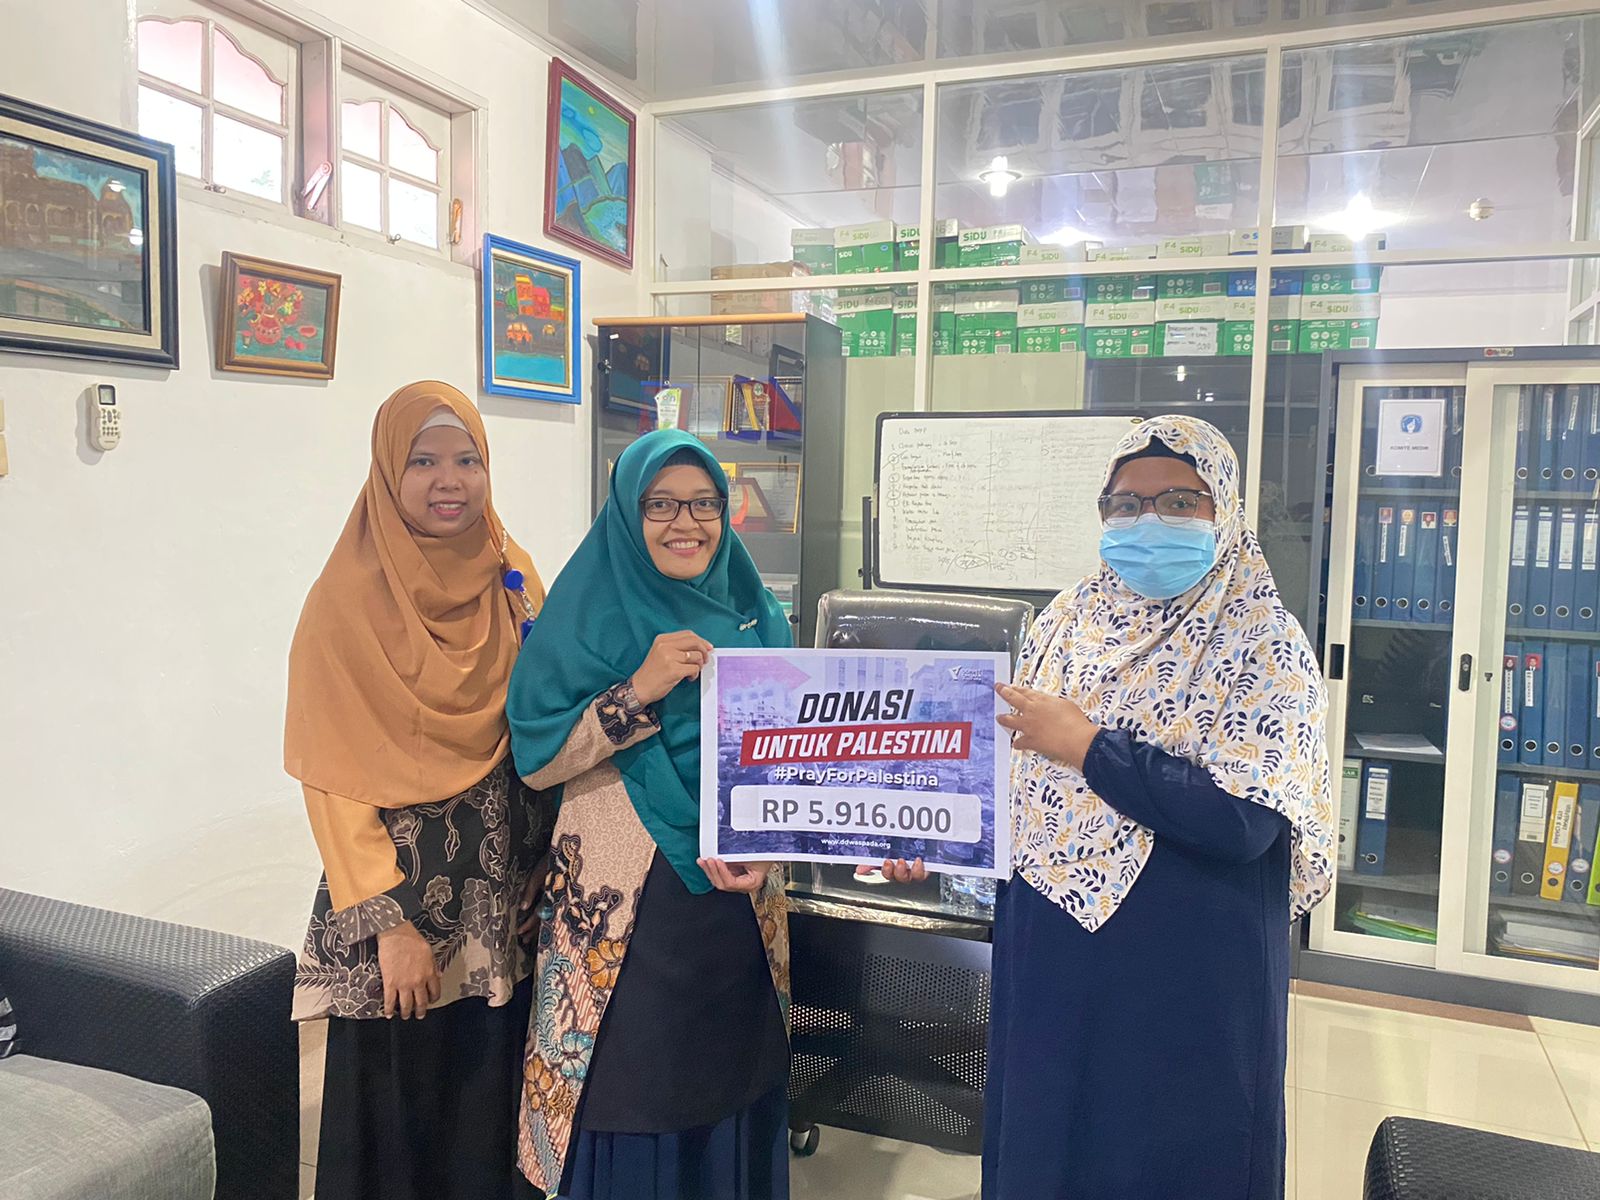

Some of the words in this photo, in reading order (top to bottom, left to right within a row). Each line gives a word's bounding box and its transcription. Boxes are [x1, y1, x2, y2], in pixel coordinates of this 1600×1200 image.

[797, 689, 914, 724] DONASI
[752, 733, 833, 760] UNTUK
[836, 729, 963, 756] PALESTINA
[774, 766, 939, 788] #PrayForPalestina
[762, 799, 799, 824] RP
[808, 800, 951, 834] 5.916.000
[820, 837, 892, 849] www.ddwaspada.org
